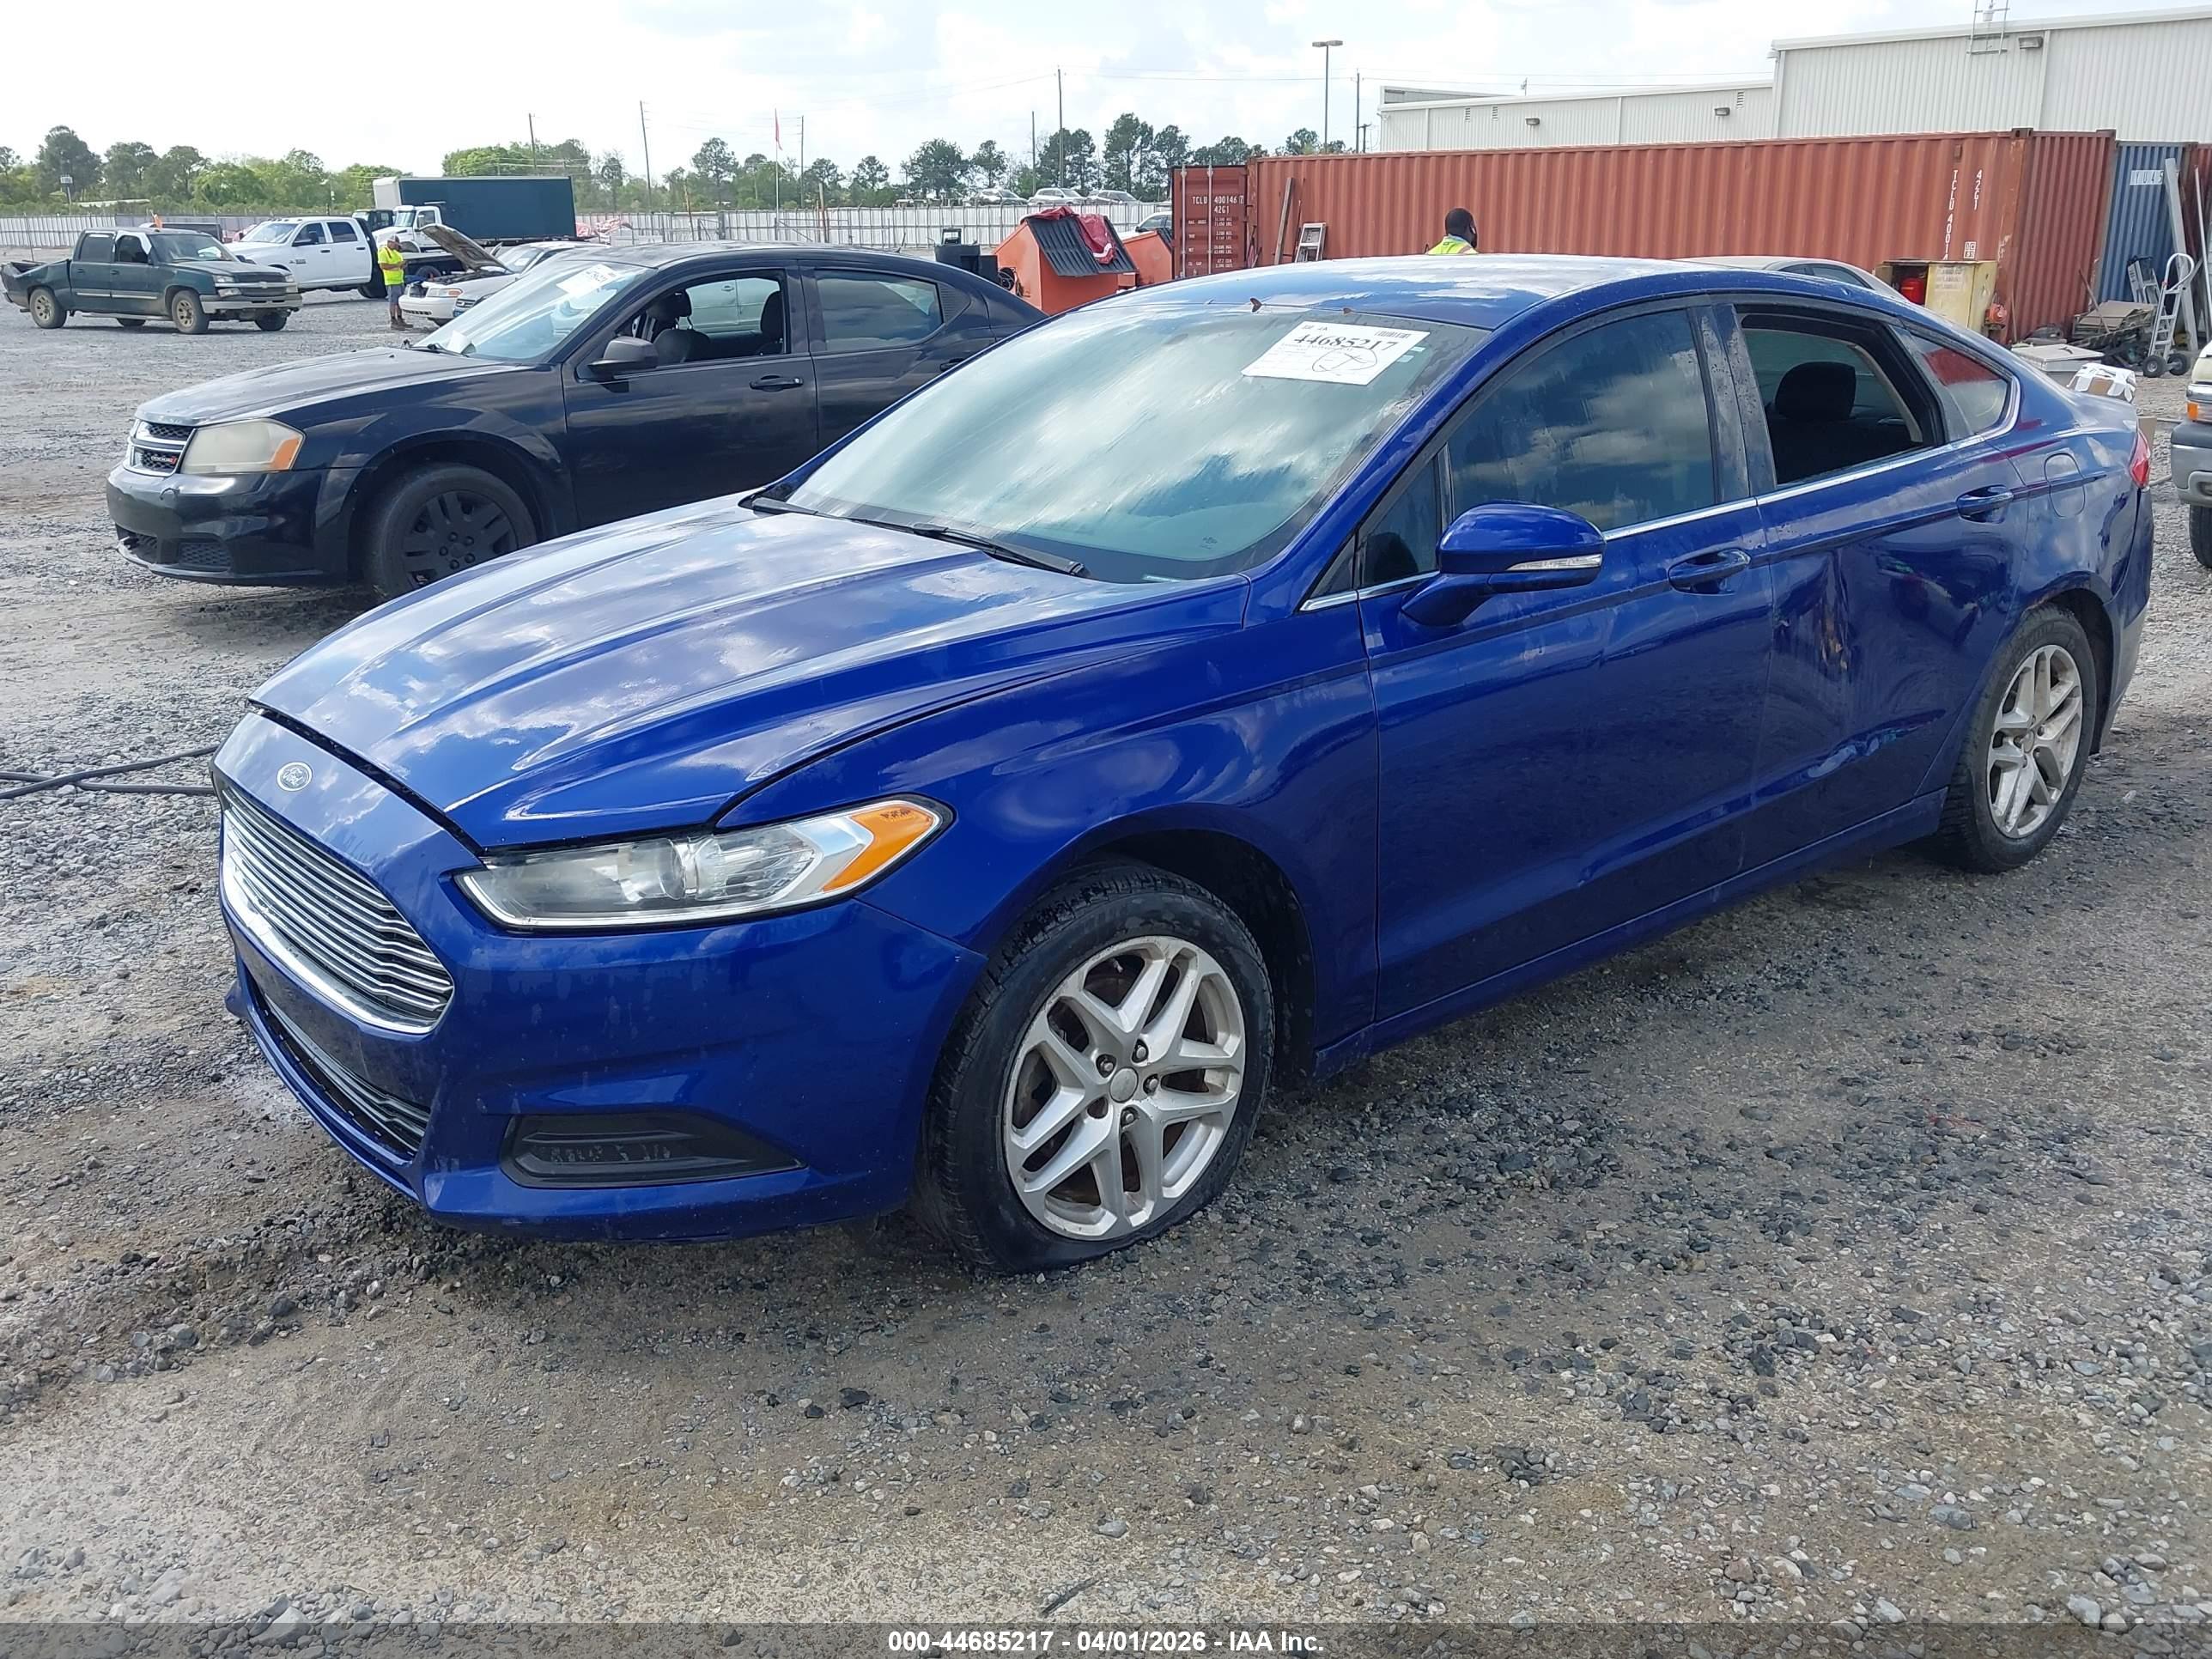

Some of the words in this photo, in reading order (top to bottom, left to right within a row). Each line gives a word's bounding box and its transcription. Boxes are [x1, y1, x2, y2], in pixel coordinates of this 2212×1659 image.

[1949, 170, 1958, 210] TCLU
[1192, 196, 1207, 204] TCLU
[1213, 195, 1237, 204] 400146
[1213, 205, 1230, 214] 42G1
[1293, 333, 1399, 352] 44685217
